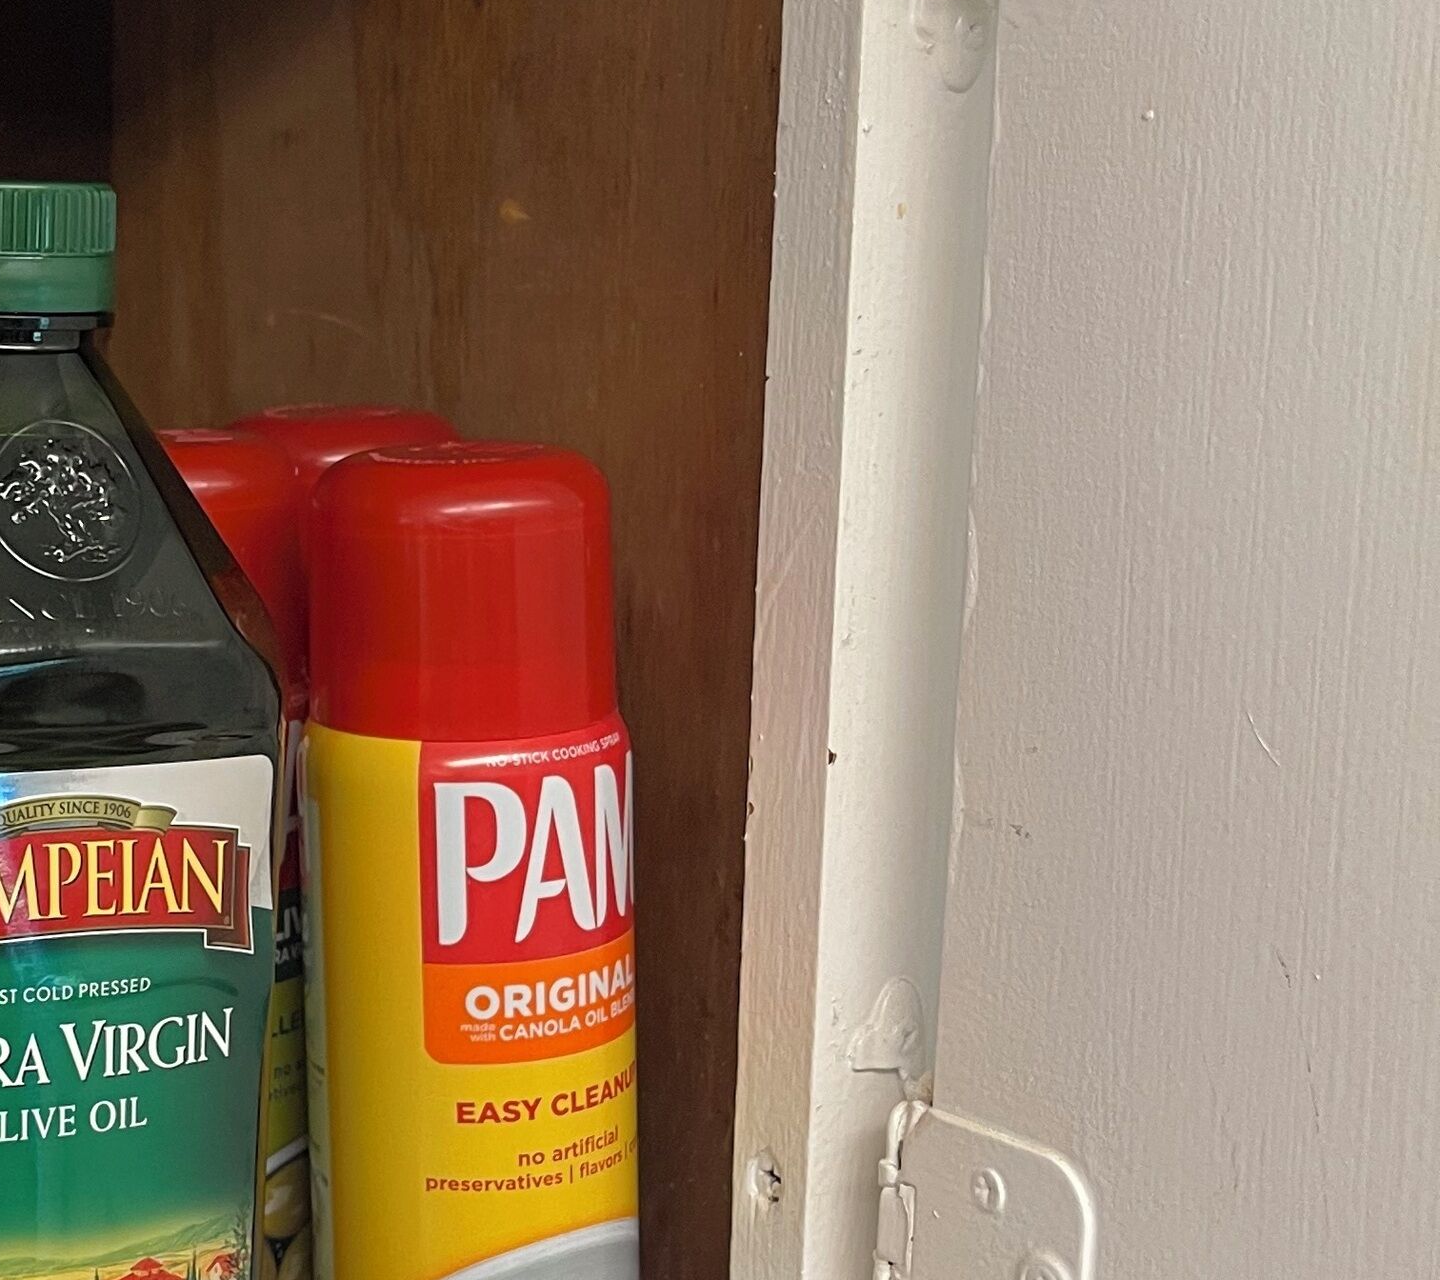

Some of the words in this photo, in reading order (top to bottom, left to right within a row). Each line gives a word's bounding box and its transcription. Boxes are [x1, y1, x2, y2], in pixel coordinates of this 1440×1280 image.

[551, 740, 601, 761] COOKING
[59, 800, 101, 815] SINCE
[103, 802, 132, 819] 1906
[22, 982, 74, 1003] COLD
[78, 976, 152, 999] PRESSED
[464, 953, 634, 1020] ORIGINAL
[460, 1022, 497, 1033] made
[498, 1014, 582, 1042] CANOLA
[584, 1009, 609, 1027] OIL
[610, 987, 635, 1018] BLEN
[59, 1007, 234, 1082] VIRGIN
[88, 1095, 148, 1131] OIL
[456, 1097, 543, 1124] EASY
[550, 1062, 635, 1116] CLEANU
[518, 1149, 546, 1167] no
[552, 1124, 620, 1162] artificial
[425, 1166, 564, 1192] preservatives
[579, 1150, 624, 1179] flavors
